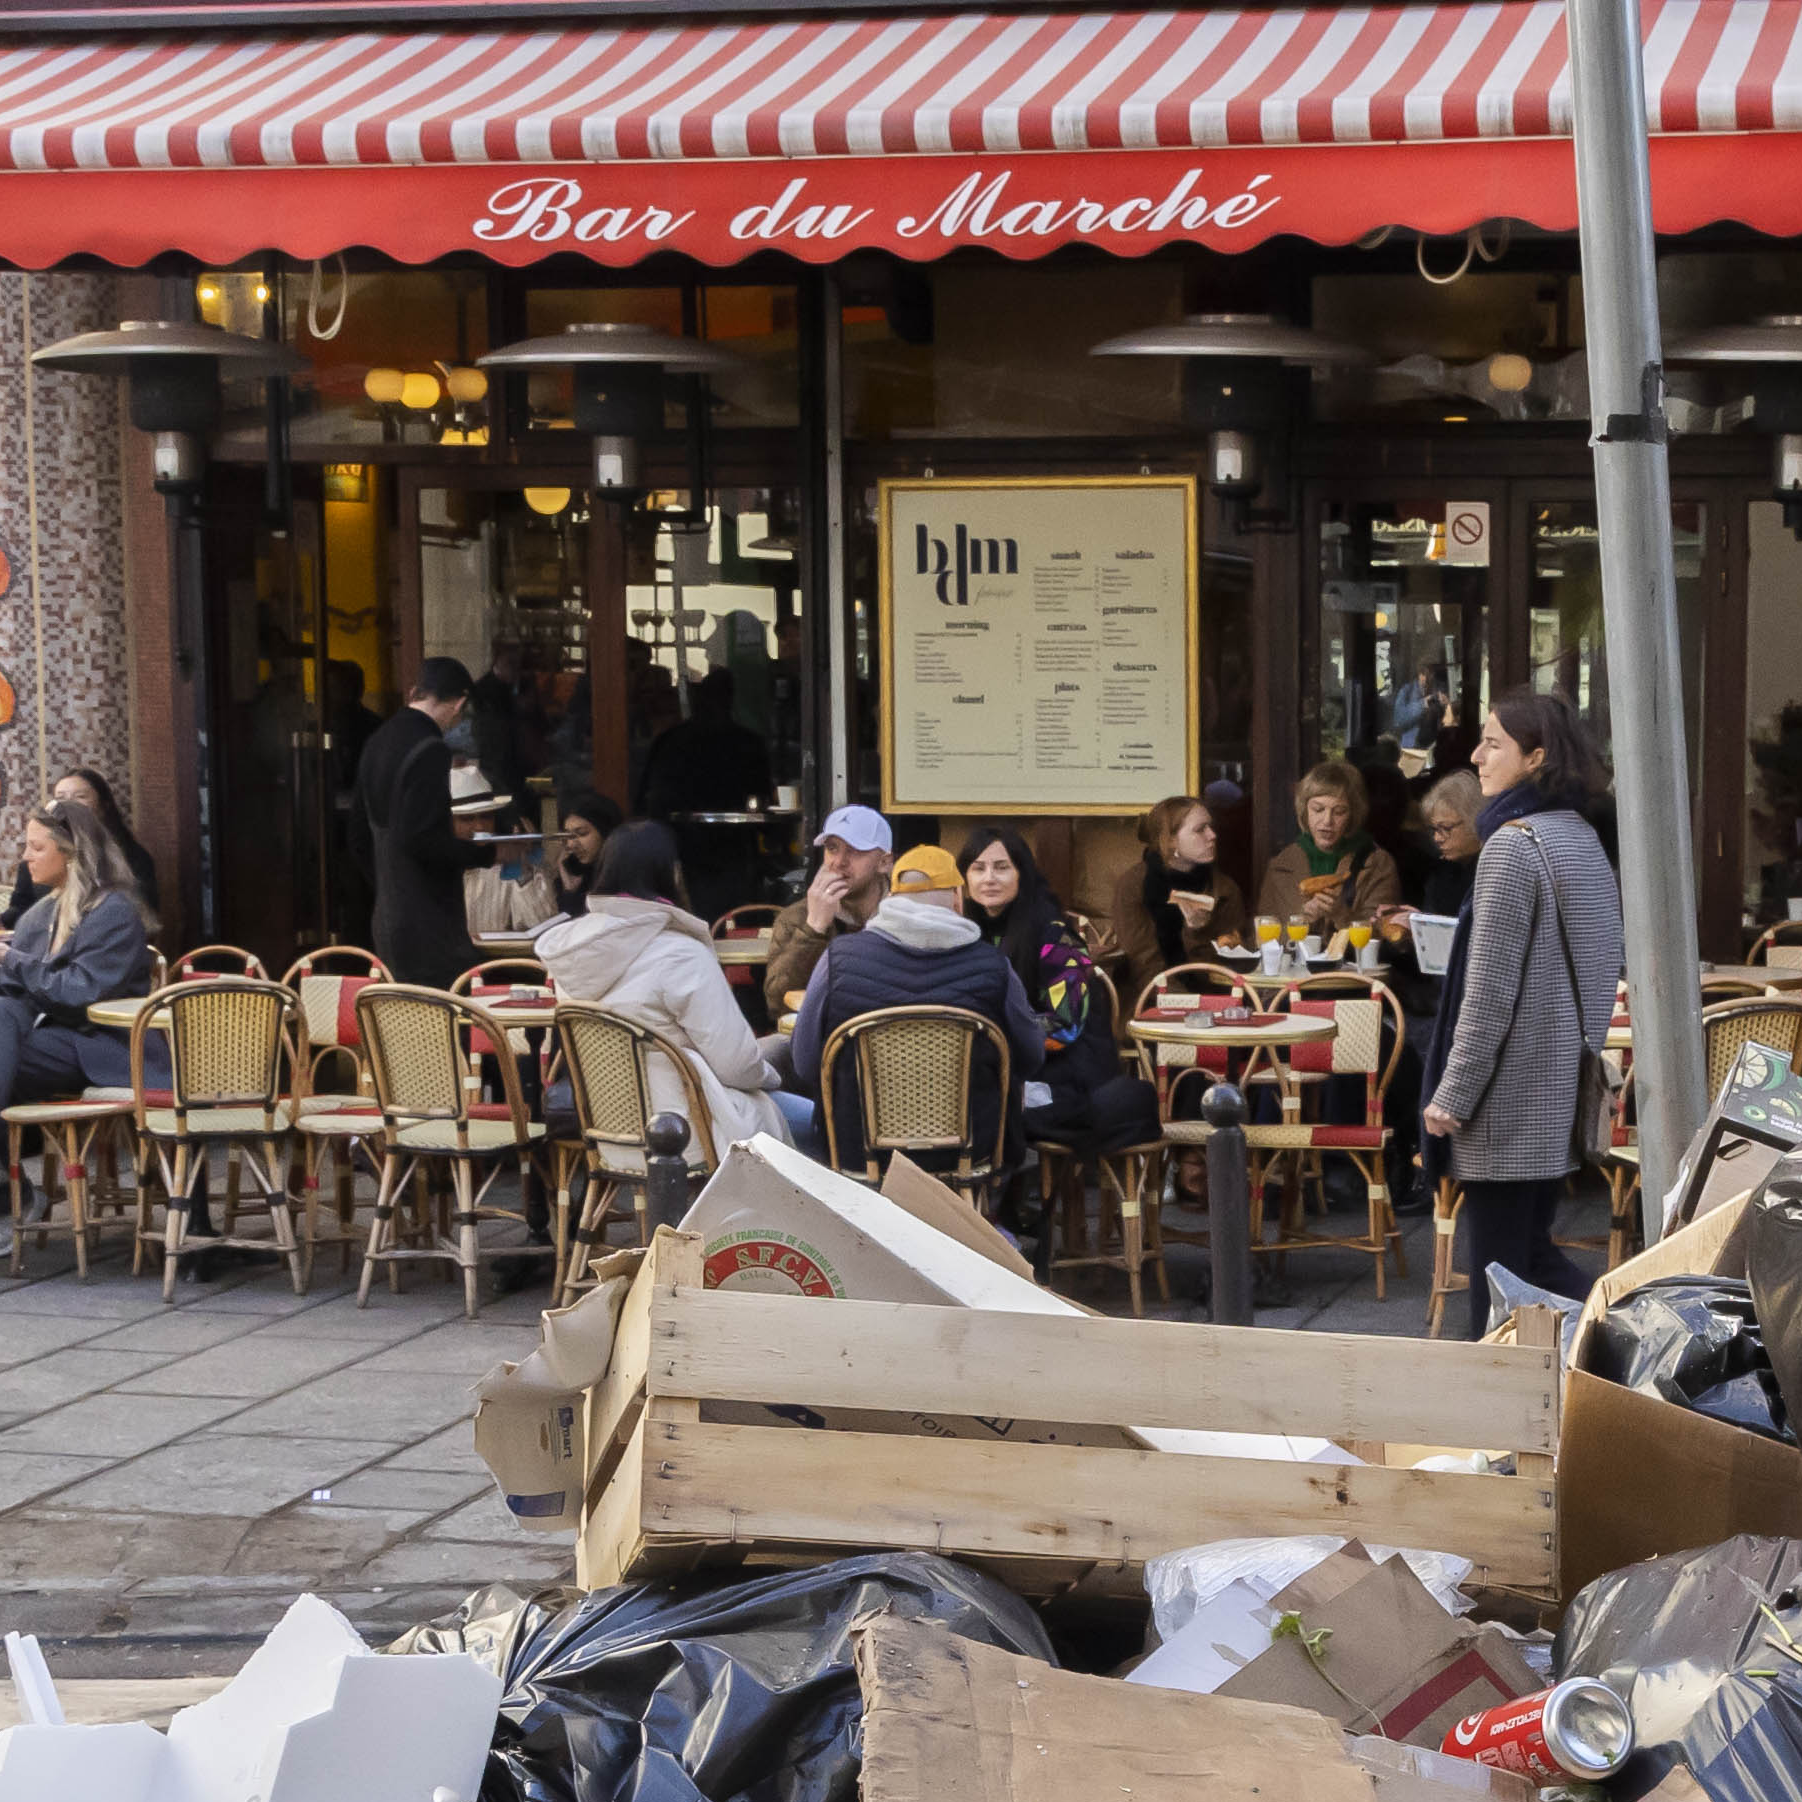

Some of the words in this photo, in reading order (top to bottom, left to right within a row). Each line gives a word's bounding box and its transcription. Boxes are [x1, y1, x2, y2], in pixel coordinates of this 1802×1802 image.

[473, 177, 696, 243] Bar
[729, 178, 875, 240] du
[896, 169, 1281, 239] Marché
